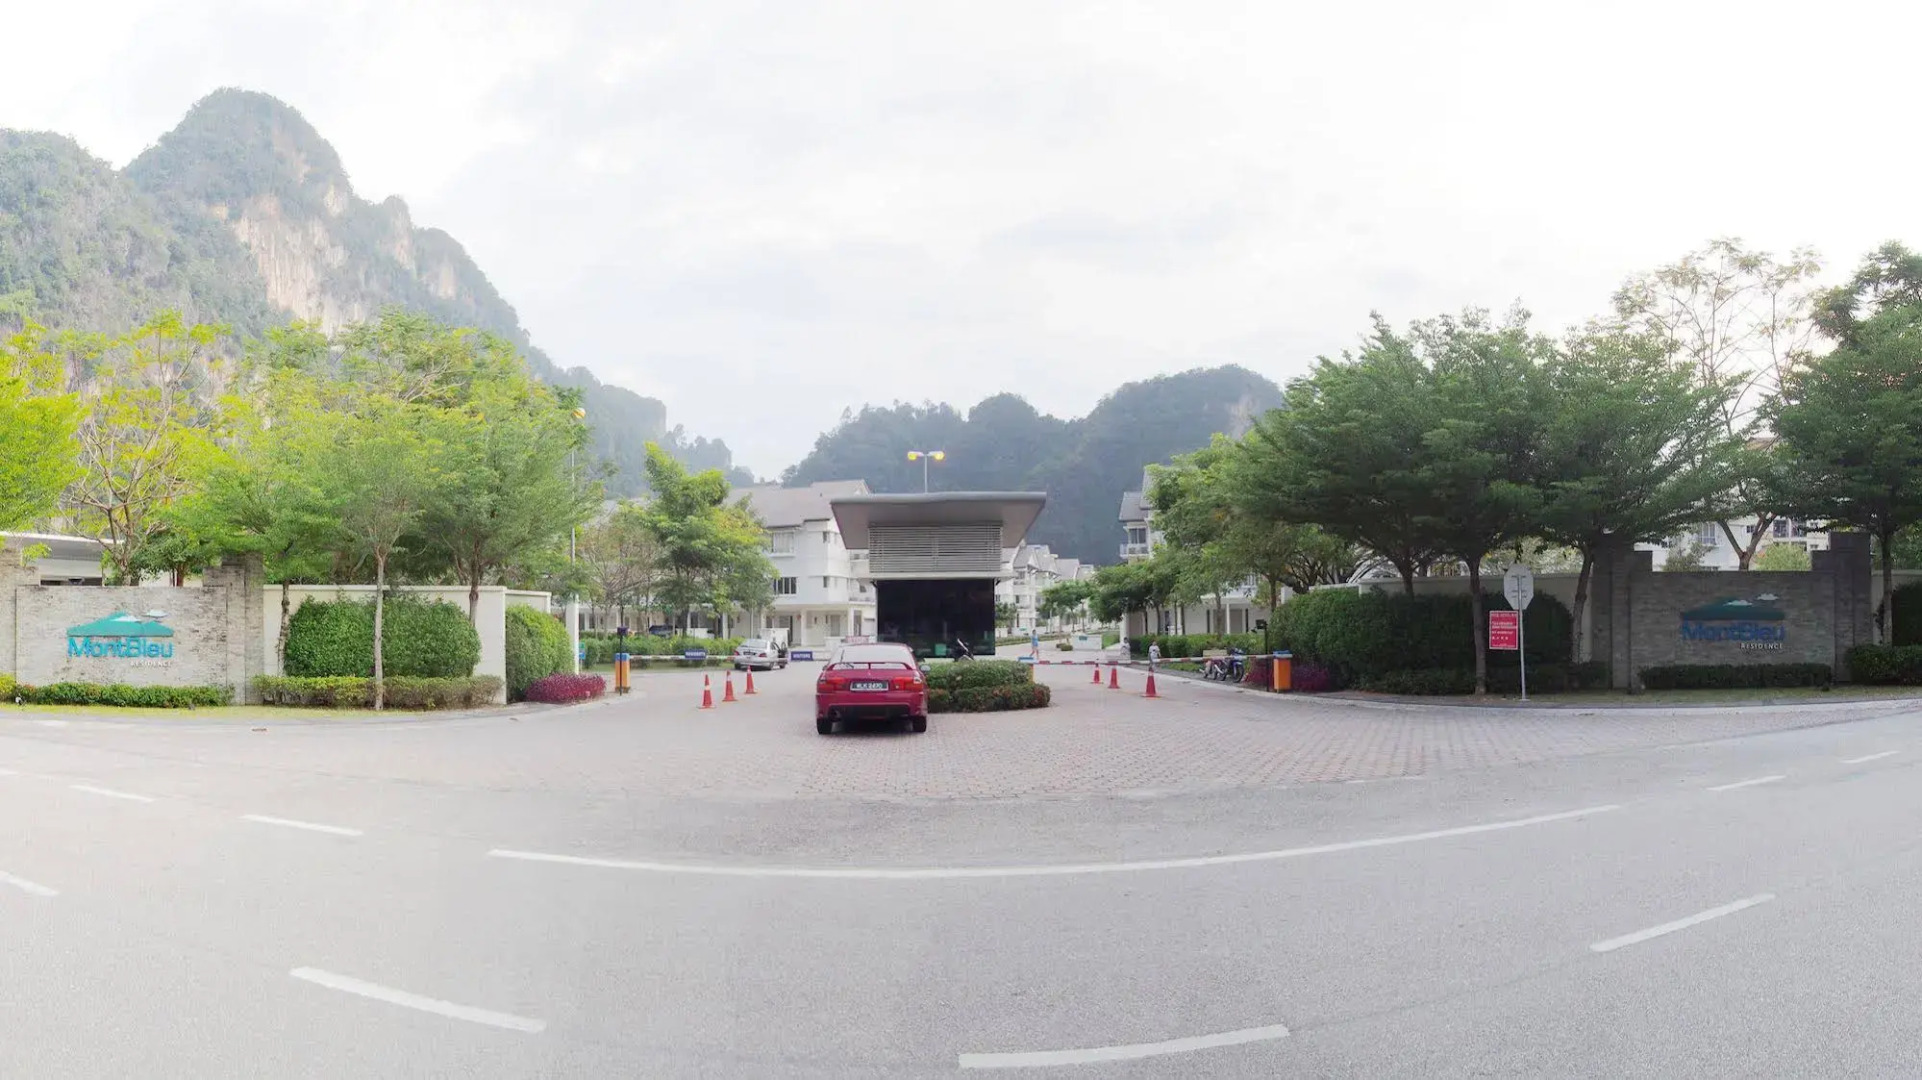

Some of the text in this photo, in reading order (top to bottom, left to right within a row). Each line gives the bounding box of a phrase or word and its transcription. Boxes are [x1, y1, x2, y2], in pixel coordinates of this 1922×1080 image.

[1681, 618, 1785, 641] MontBleu
[67, 636, 174, 658] MontBleu
[1740, 642, 1783, 650] RESIDENCE
